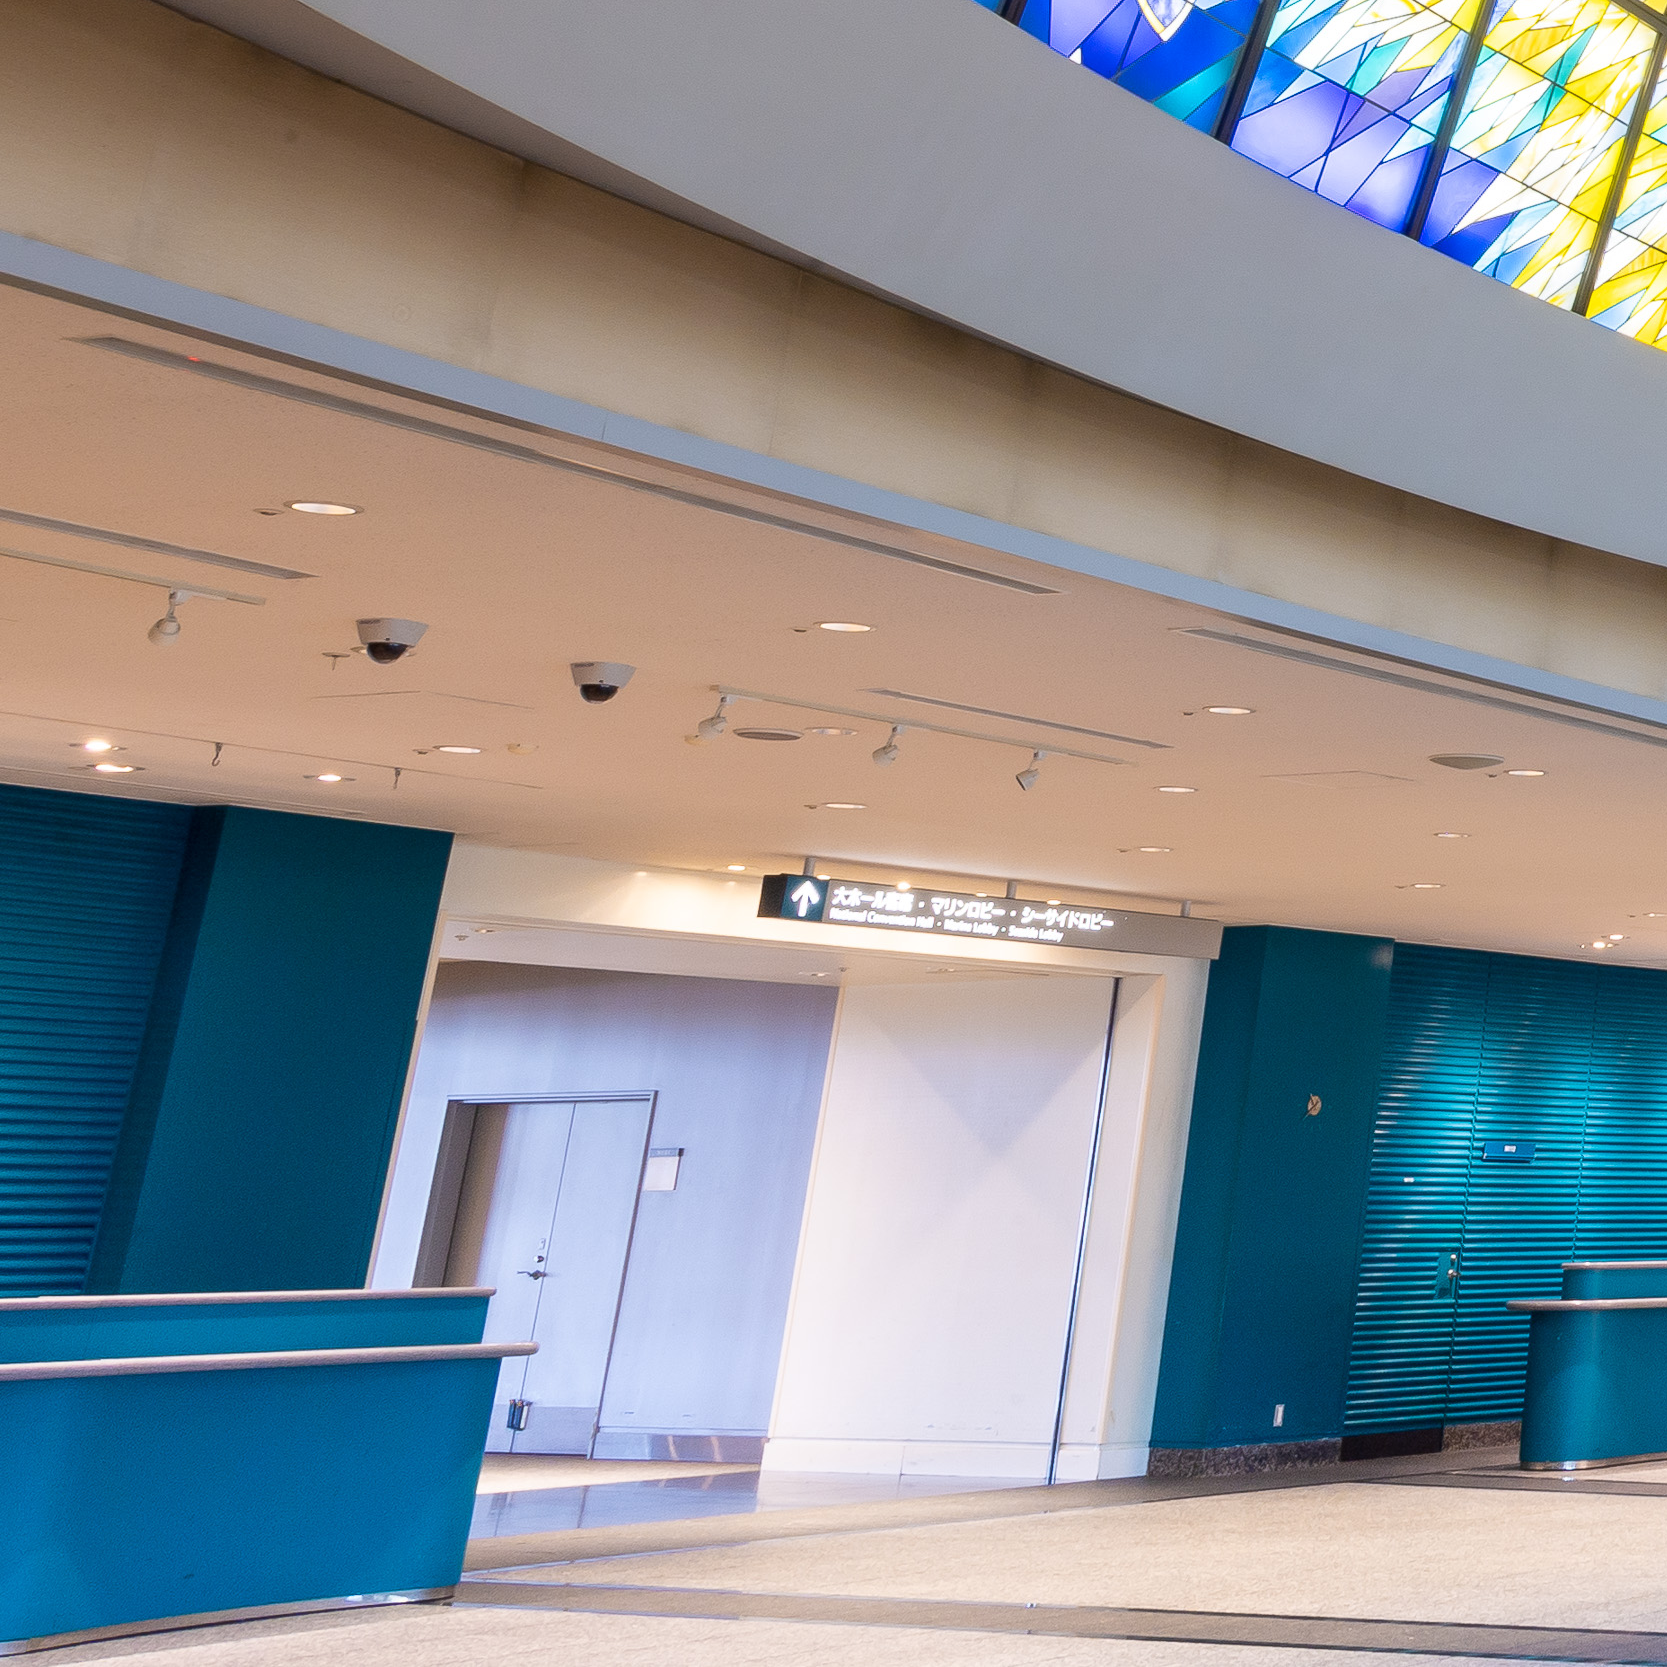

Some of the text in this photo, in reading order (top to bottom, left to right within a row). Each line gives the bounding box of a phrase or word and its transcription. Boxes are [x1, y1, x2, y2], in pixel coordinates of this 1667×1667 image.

[930, 897, 1006, 920] マリンロビー
[1020, 906, 1114, 931] シーサイドロビー
